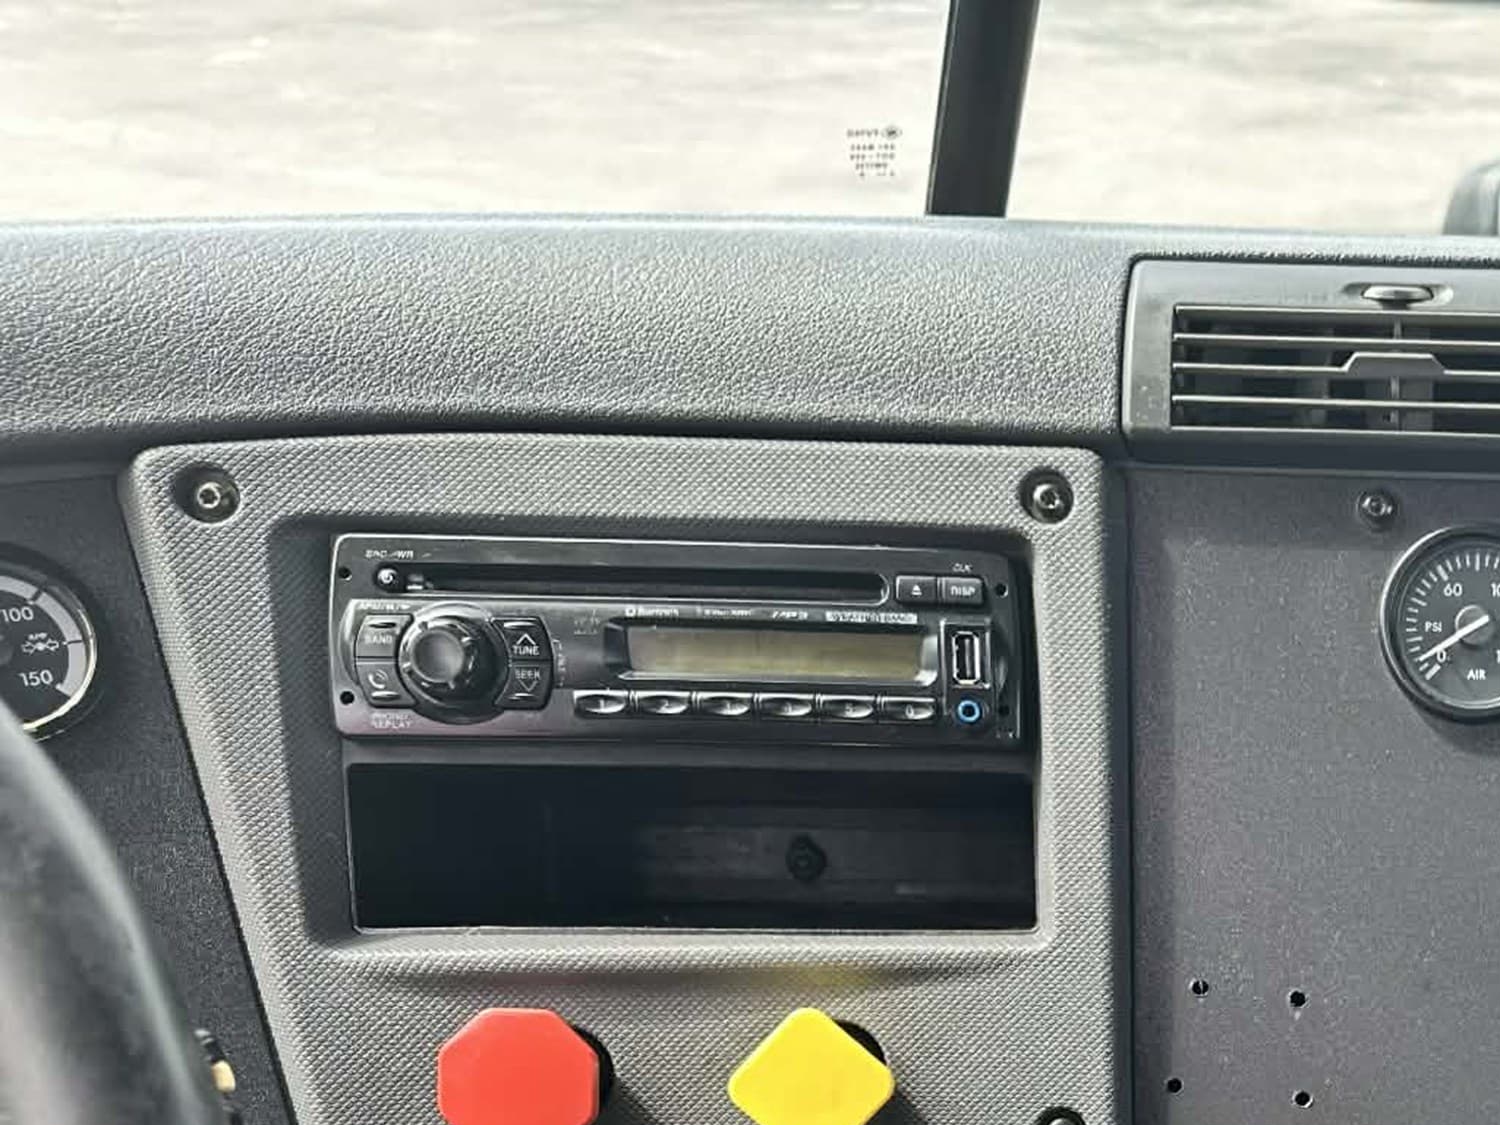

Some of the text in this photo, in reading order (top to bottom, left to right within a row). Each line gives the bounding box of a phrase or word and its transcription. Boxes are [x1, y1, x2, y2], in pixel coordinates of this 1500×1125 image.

[951, 585, 976, 596] DISP
[1443, 583, 1463, 597] 60
[1, 607, 34, 623] 100
[1424, 621, 1443, 633] PSI
[512, 645, 540, 656] TUNE
[1436, 650, 1447, 663] 0
[19, 669, 54, 688] 150
[514, 669, 541, 680] SEEK
[1466, 669, 1487, 680] AIR
